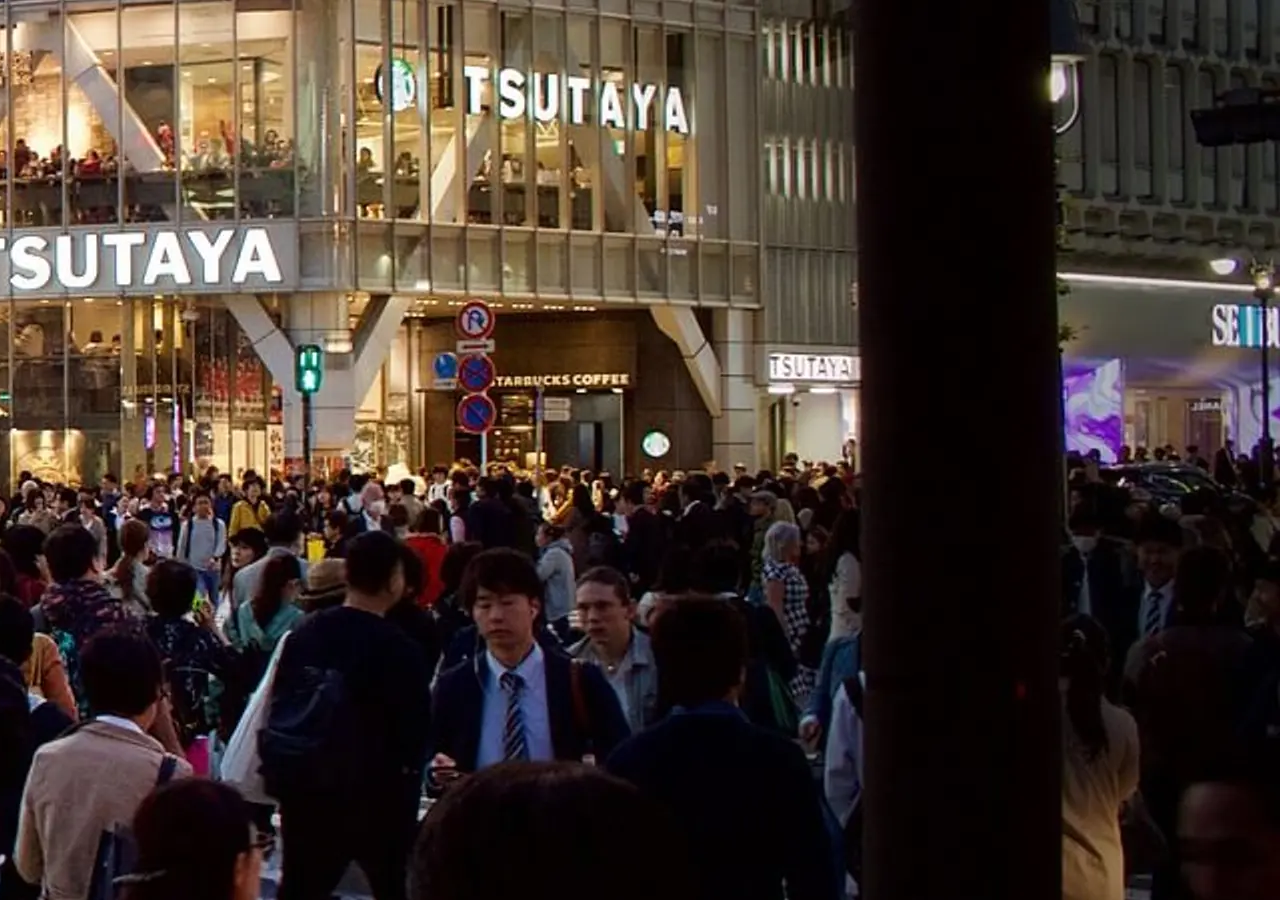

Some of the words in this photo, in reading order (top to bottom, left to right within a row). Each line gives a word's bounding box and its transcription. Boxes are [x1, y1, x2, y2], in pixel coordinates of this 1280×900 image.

[464, 66, 690, 134] TSUTAYA
[1212, 304, 1280, 348] SEIB
[573, 373, 630, 386] COFFEE
[771, 356, 850, 378] TSUTAYA
